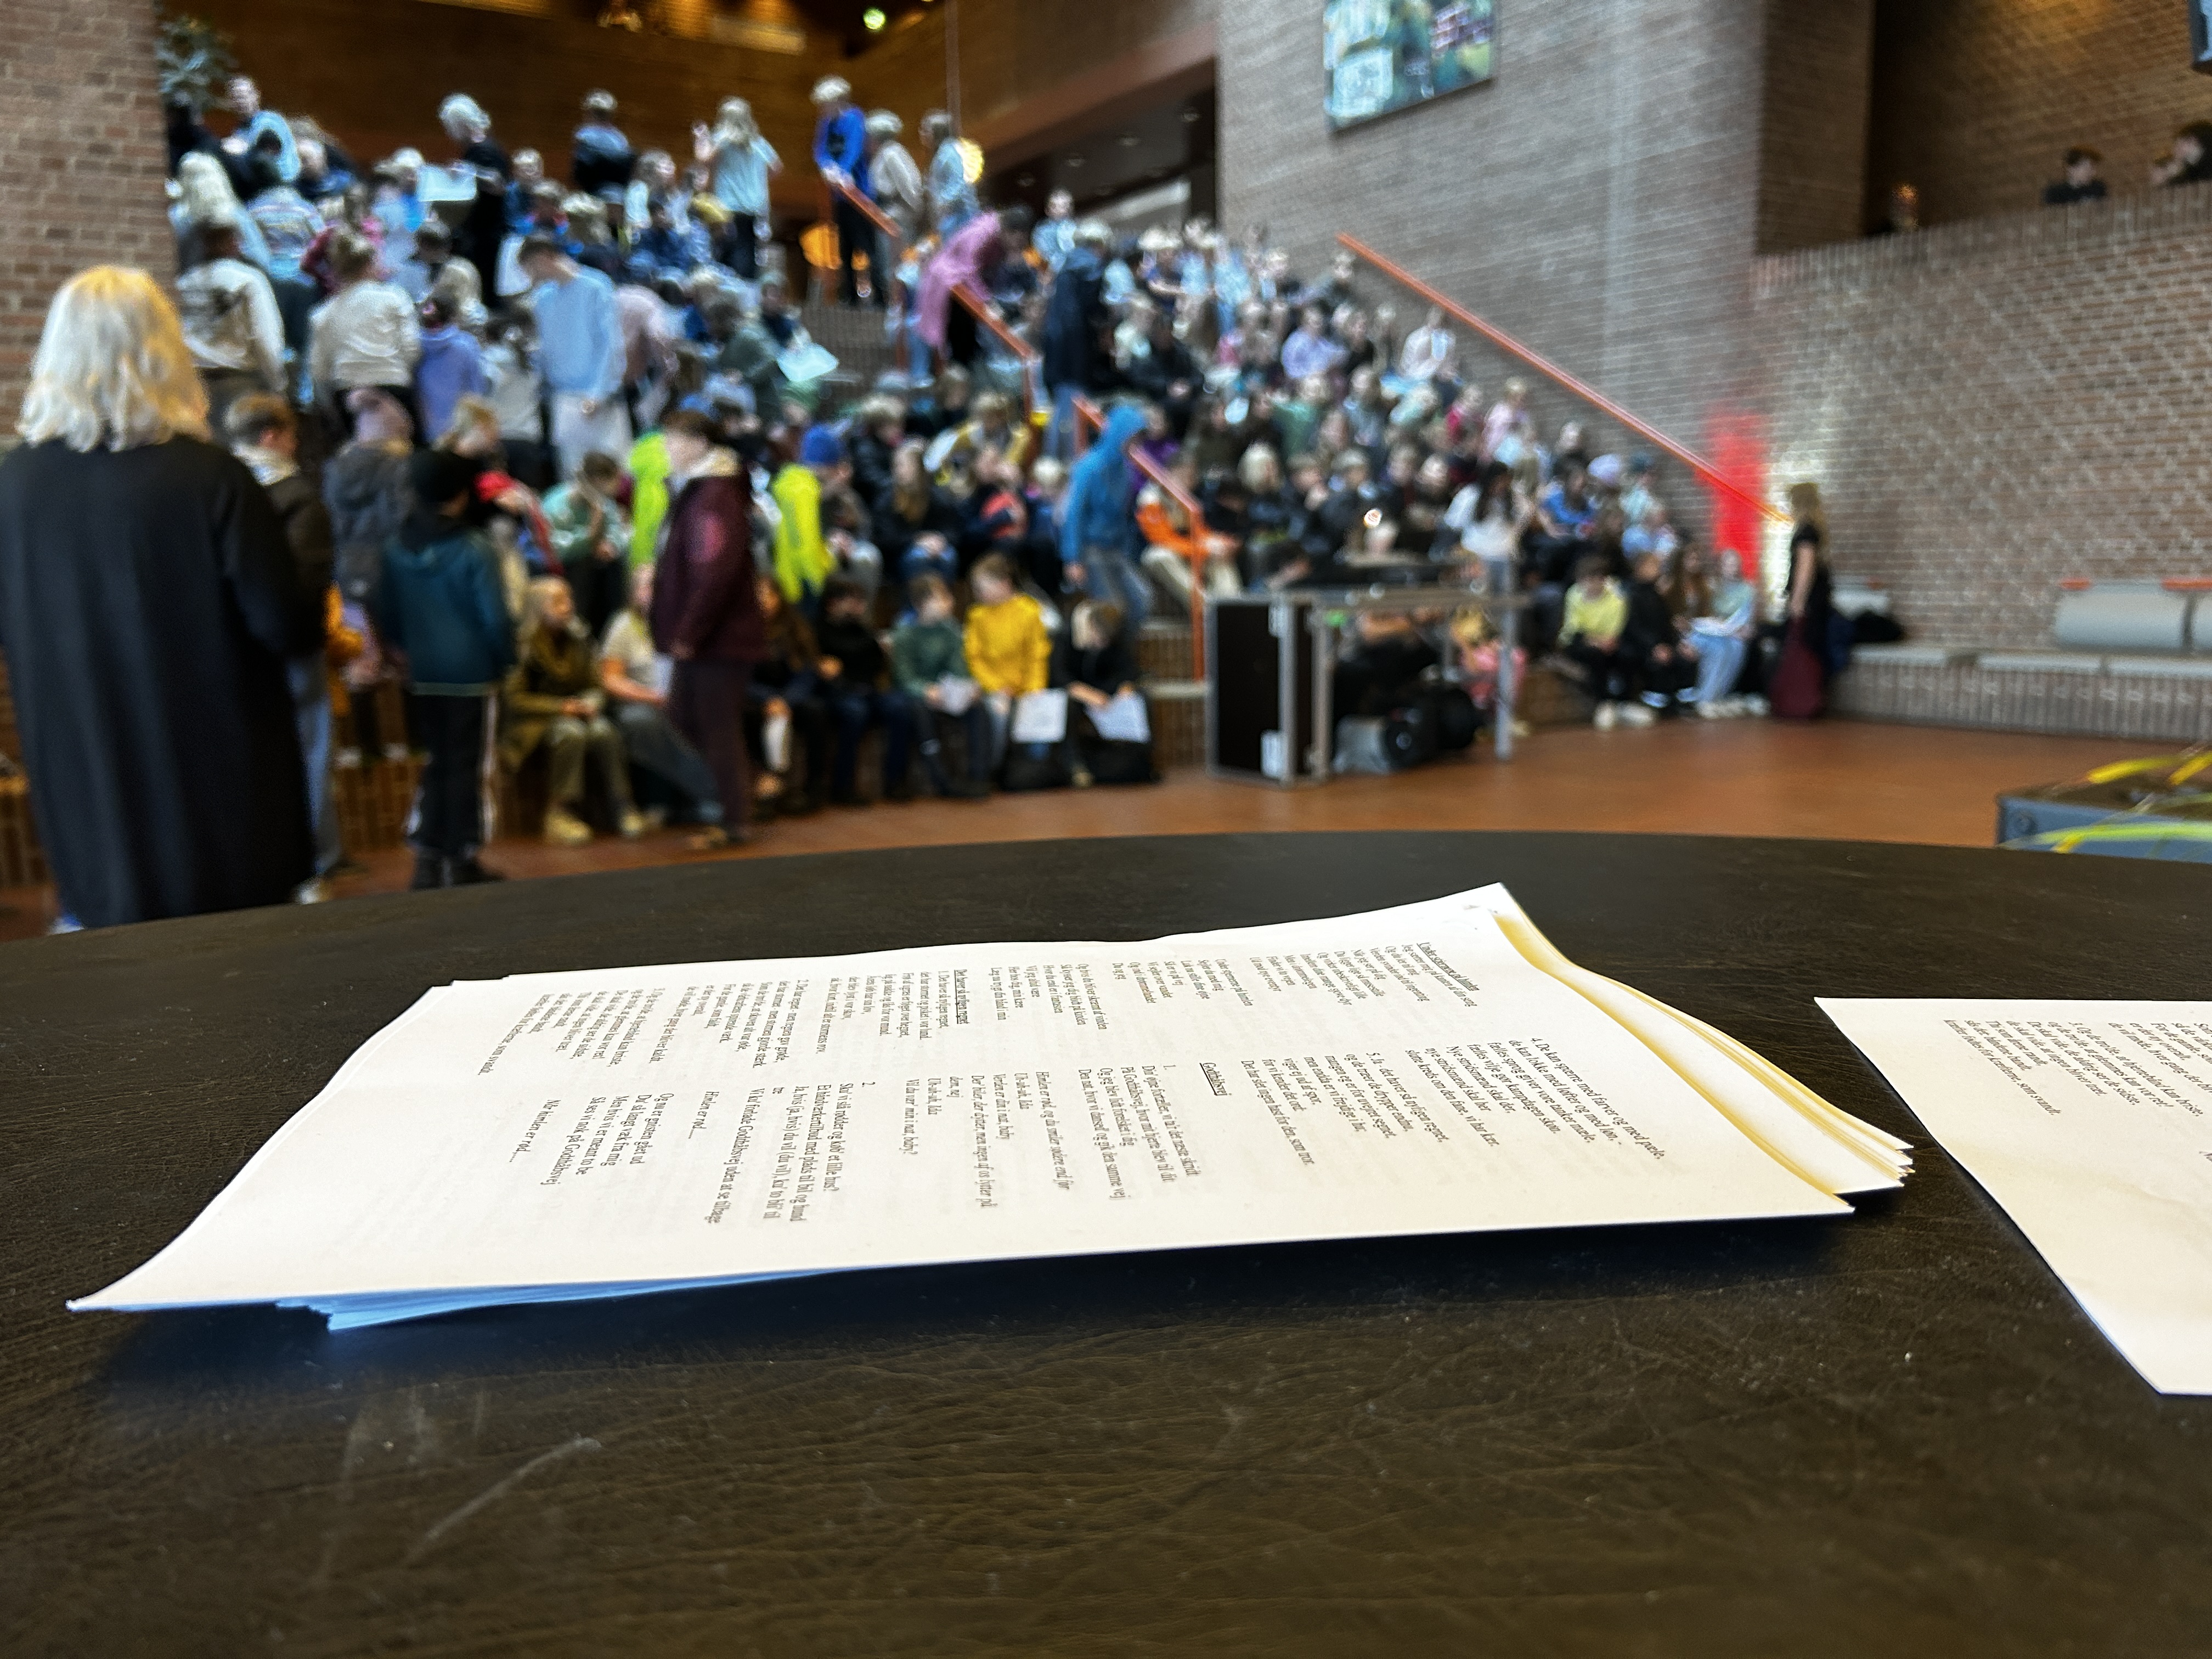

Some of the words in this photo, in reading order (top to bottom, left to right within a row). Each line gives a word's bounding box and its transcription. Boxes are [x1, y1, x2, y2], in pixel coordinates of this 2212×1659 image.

[1424, 1048, 1441, 1058] nye
[1466, 1044, 1489, 1059] fælles
[1379, 1068, 1395, 1077] det
[1434, 1058, 1474, 1089] stridsmænd
[1446, 1046, 1463, 1057] Nye
[1457, 1058, 1498, 1089] stridsmænd
[1486, 1090, 1510, 1101] skal
[1483, 1060, 1503, 1073] vilje
[1199, 1062, 1232, 1096] Godthåbsvej
[1386, 1077, 1407, 1093] haver
[1491, 1073, 1513, 1083] gør
[792, 1086, 810, 1094] Ja,
[1356, 1068, 1375, 1082] træer
[1374, 1090, 1399, 1111] drypper
[1404, 1049, 1424, 1064] slutte
[1417, 1063, 1439, 1079] kreds
[1431, 1080, 1446, 1089] om
[1440, 1090, 1457, 1101] den
[1449, 1101, 1469, 1116] fane,
[1470, 1122, 1488, 1132] har
[1487, 1042, 1510, 1058] fælles
[1501, 1058, 1526, 1074] sprog
[1515, 1074, 1543, 1090] giver
[1536, 1090, 1556, 1104] vore
[1549, 1104, 1577, 1123] tanker
[1569, 1124, 1596, 1143] mæle,
[1515, 1047, 1532, 1057] kan
[1525, 1057, 1549, 1074] lokke
[1542, 1074, 1567, 1087] med
[1556, 1087, 1582, 1104] løfter
[1574, 1105, 1591, 1114] og
[1583, 1114, 1611, 1127] med
[1534, 1043, 1550, 1052] De
[1544, 1052, 1561, 1063] kan
[1554, 1063, 1583, 1082] spærre
[1576, 1083, 1602, 1097] med
[1591, 1097, 1620, 1116] farver
[1612, 1116, 1629, 1126] og
[1622, 1126, 1650, 1141] med
[610, 1095, 630, 1108] Men
[653, 1093, 675, 1102] Og
[699, 1091, 720, 1110] Himlen
[747, 1095, 763, 1103] ku'
[791, 1093, 808, 1105] hvis
[1463, 1089, 1486, 1101] skal
[1505, 1084, 1545, 1117] kampdagen
[542, 1099, 561, 1110] Når
[584, 1104, 598, 1114] ses
[786, 1105, 805, 1116] (ja,
[836, 1101, 851, 1110] slå
[1403, 1101, 1431, 1122] nyligen
[1474, 1101, 1492, 1111] her
[528, 1111, 554, 1131] himlen
[603, 1108, 623, 1121] hvis
[620, 1111, 644, 1127] langt
[740, 1104, 760, 1125] forlade
[807, 1091, 831, 1141] håndværkertilbud
[833, 1110, 849, 1130] rødder
[573, 1121, 589, 1134] nok
[640, 1118, 662, 1140] gnisten
[782, 1115, 803, 1131] hvis)
[566, 1135, 585, 1143] på
[616, 1127, 633, 1142] væk
[783, 1132, 799, 1141] du
[827, 1131, 843, 1140] og
[584, 1137, 604, 1158] meant
[611, 1142, 630, 1152] fra
[633, 1141, 653, 1155] gået
[723, 1125, 754, 1165] Godthåbsvej
[781, 1142, 797, 1150] vil
[804, 1141, 820, 1155] med
[540, 1144, 580, 1186] Godthåbsvej
[600, 1153, 623, 1166] mig
[629, 1155, 645, 1165] ud
[798, 1156, 819, 1174] plads
[575, 1166, 594, 1175] be
[722, 1166, 741, 1183] uden
[826, 1162, 843, 1176] lille
[772, 1178, 790, 1189] ku'
[799, 1175, 816, 1183] til
[823, 1176, 841, 1192] hus?
[796, 1183, 815, 1193] bil
[789, 1194, 808, 1204] og
[763, 1211, 781, 1219] til
[789, 1204, 810, 1222] hund
